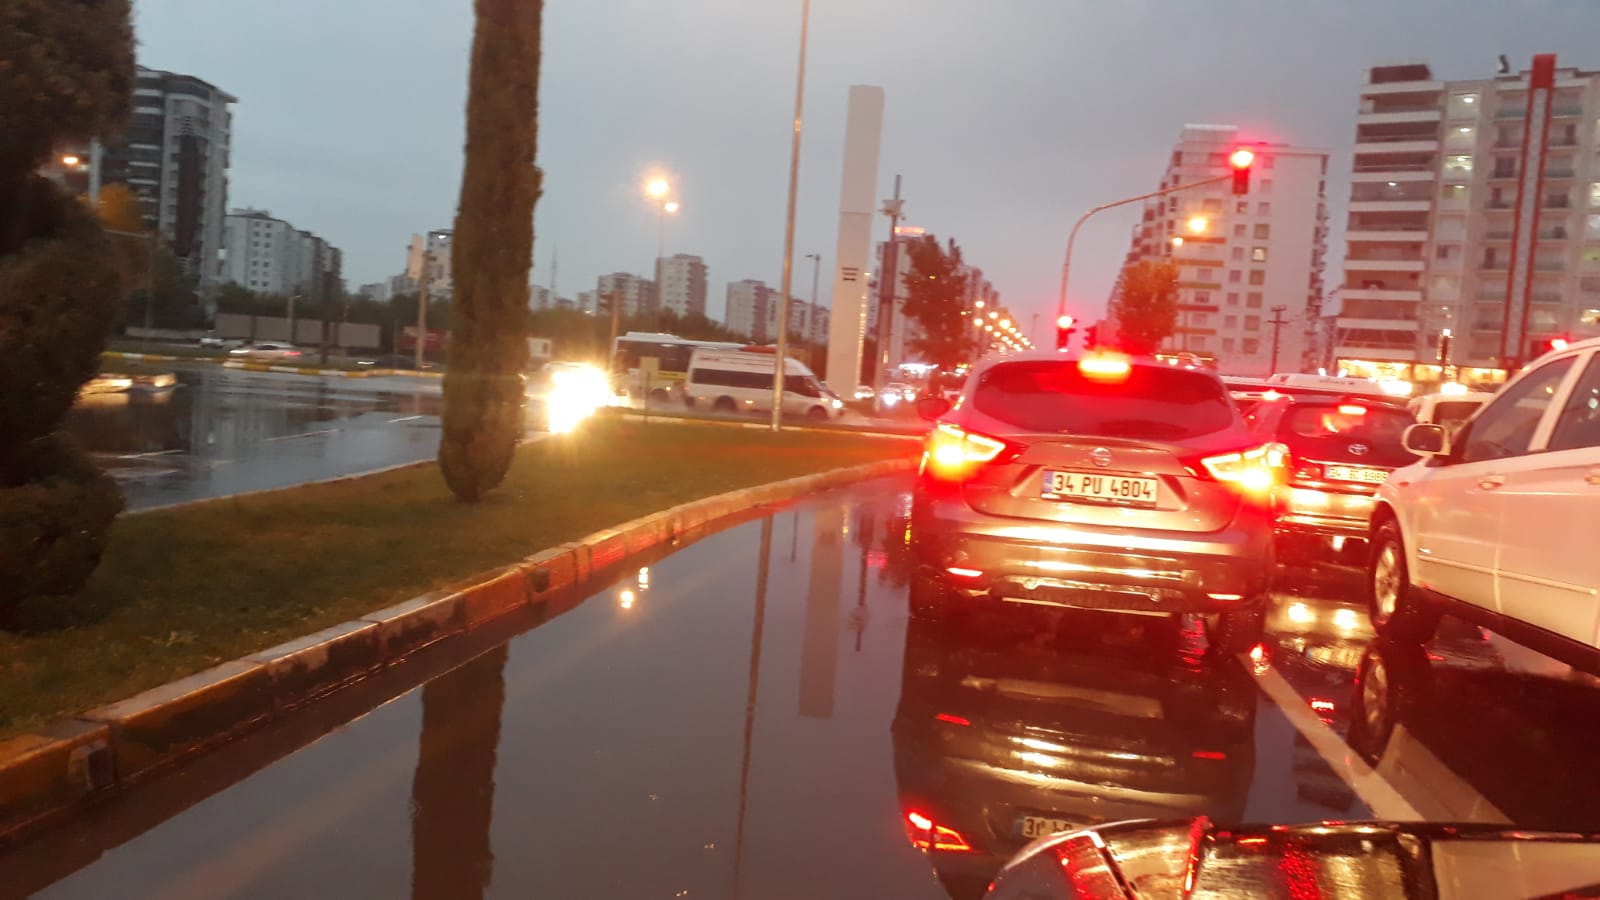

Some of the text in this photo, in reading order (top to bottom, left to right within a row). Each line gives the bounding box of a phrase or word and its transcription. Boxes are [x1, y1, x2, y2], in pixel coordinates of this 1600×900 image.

[1055, 474, 1152, 499] 34 PU 4804
